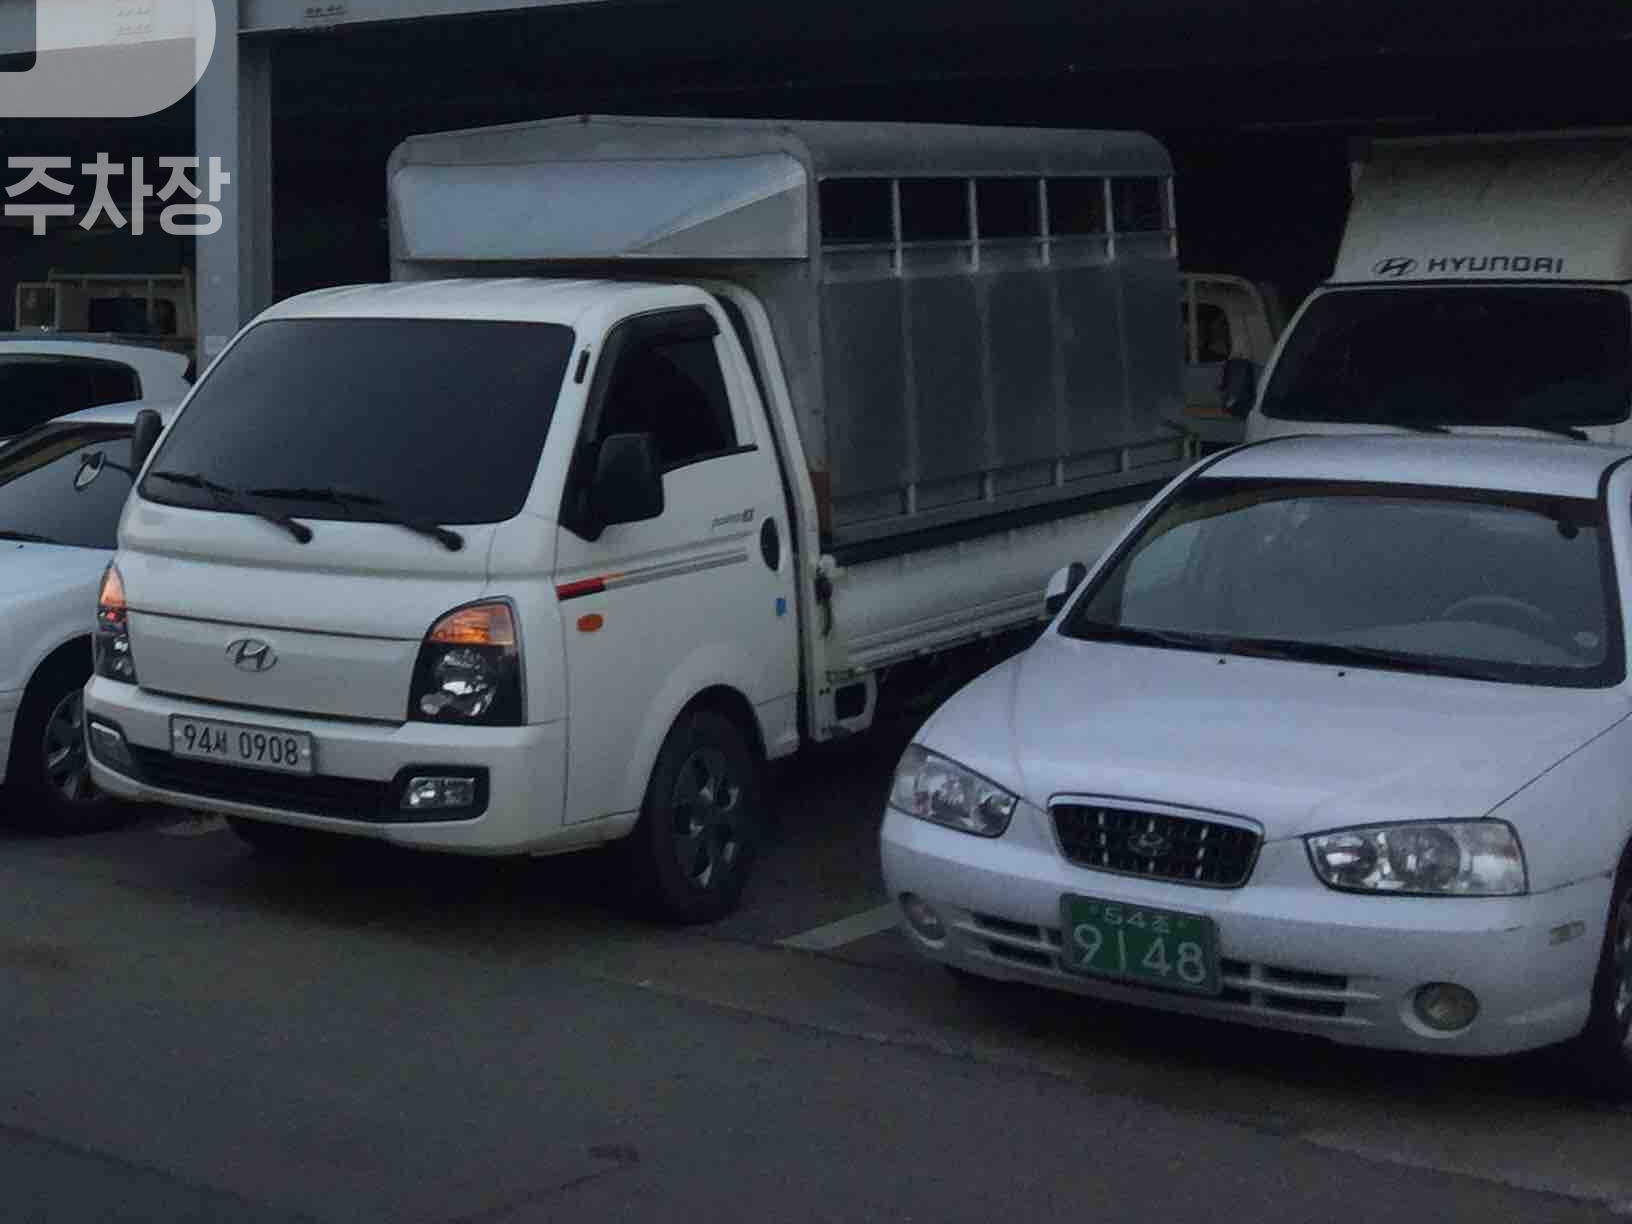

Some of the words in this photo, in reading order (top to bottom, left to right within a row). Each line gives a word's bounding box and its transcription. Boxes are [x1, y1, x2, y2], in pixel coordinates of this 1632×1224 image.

[1428, 256, 1564, 274] HYUNDAI
[239, 730, 300, 766] 0908
[1072, 922, 1207, 985] 9148
